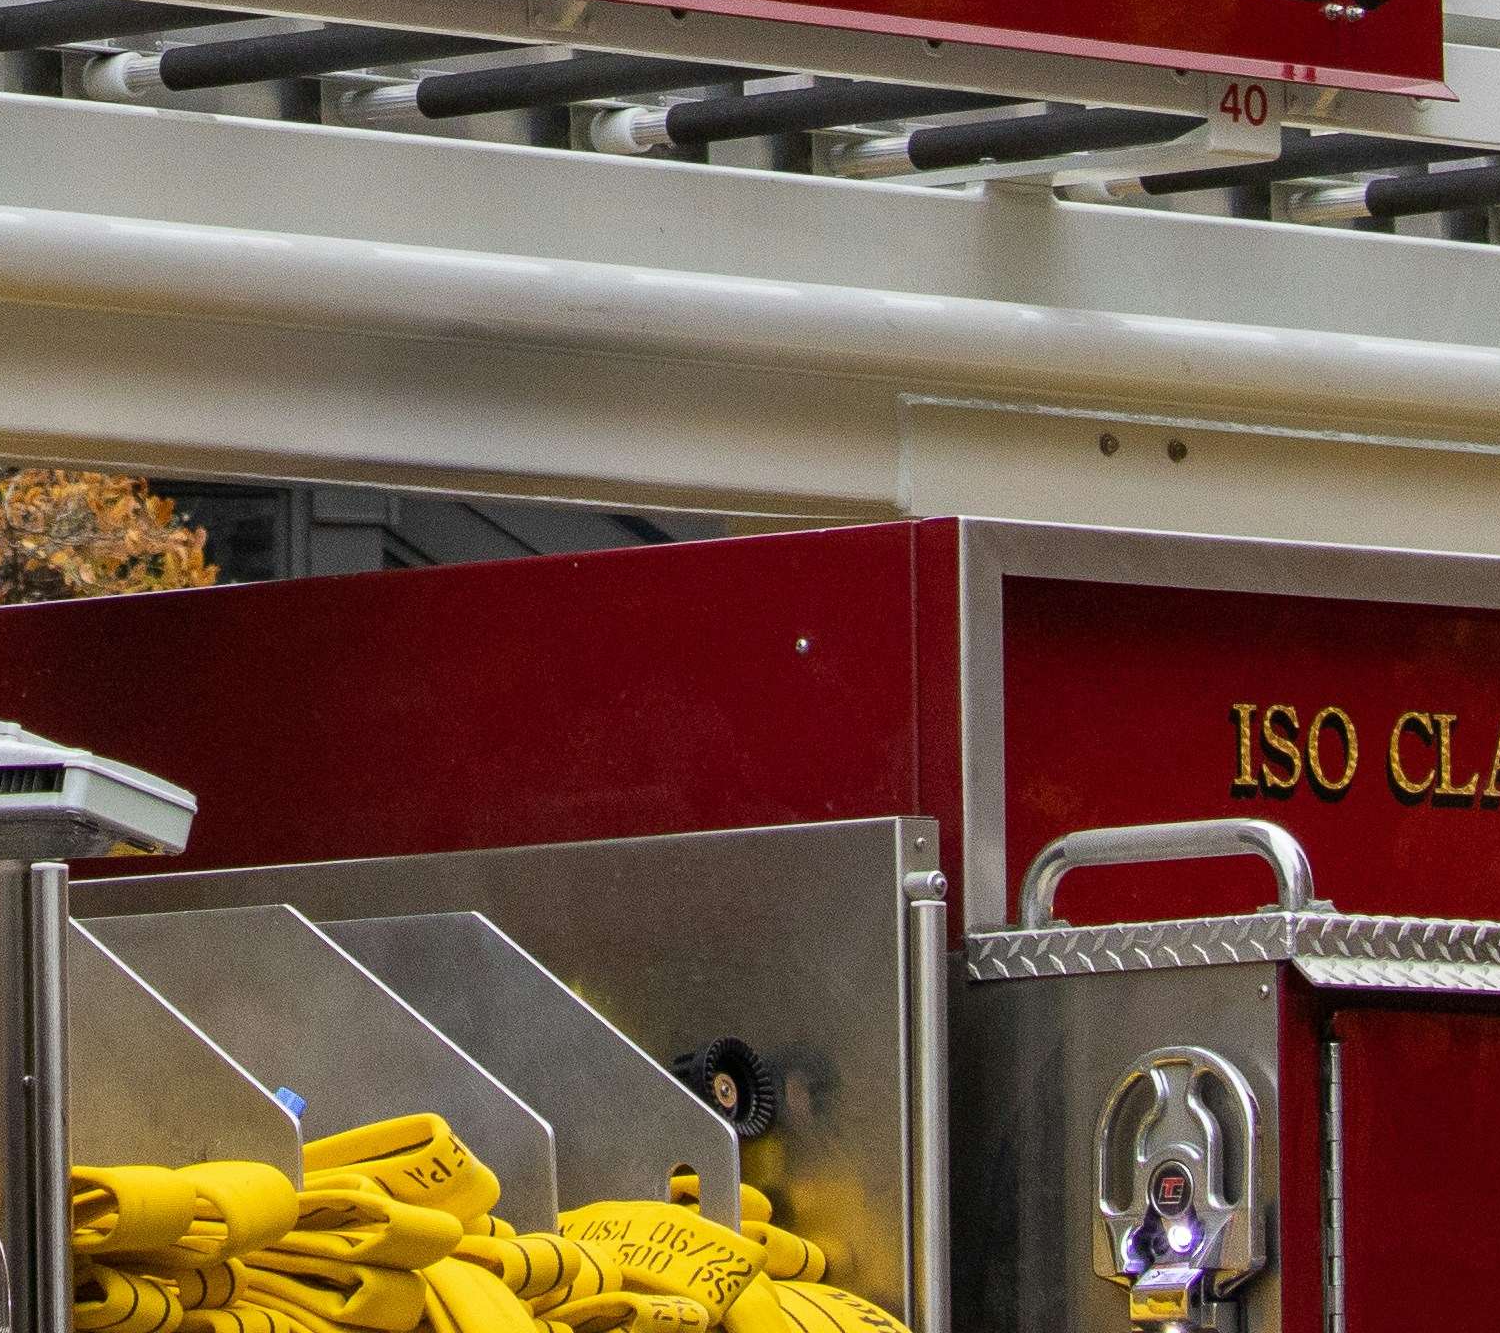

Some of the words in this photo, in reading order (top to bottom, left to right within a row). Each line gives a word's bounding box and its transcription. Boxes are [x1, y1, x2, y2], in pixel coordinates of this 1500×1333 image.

[1221, 83, 1268, 126] 40
[1230, 703, 1359, 802] ISO
[580, 1219, 633, 1241] USA
[648, 1220, 753, 1278] 06/22
[613, 1243, 674, 1274] 500
